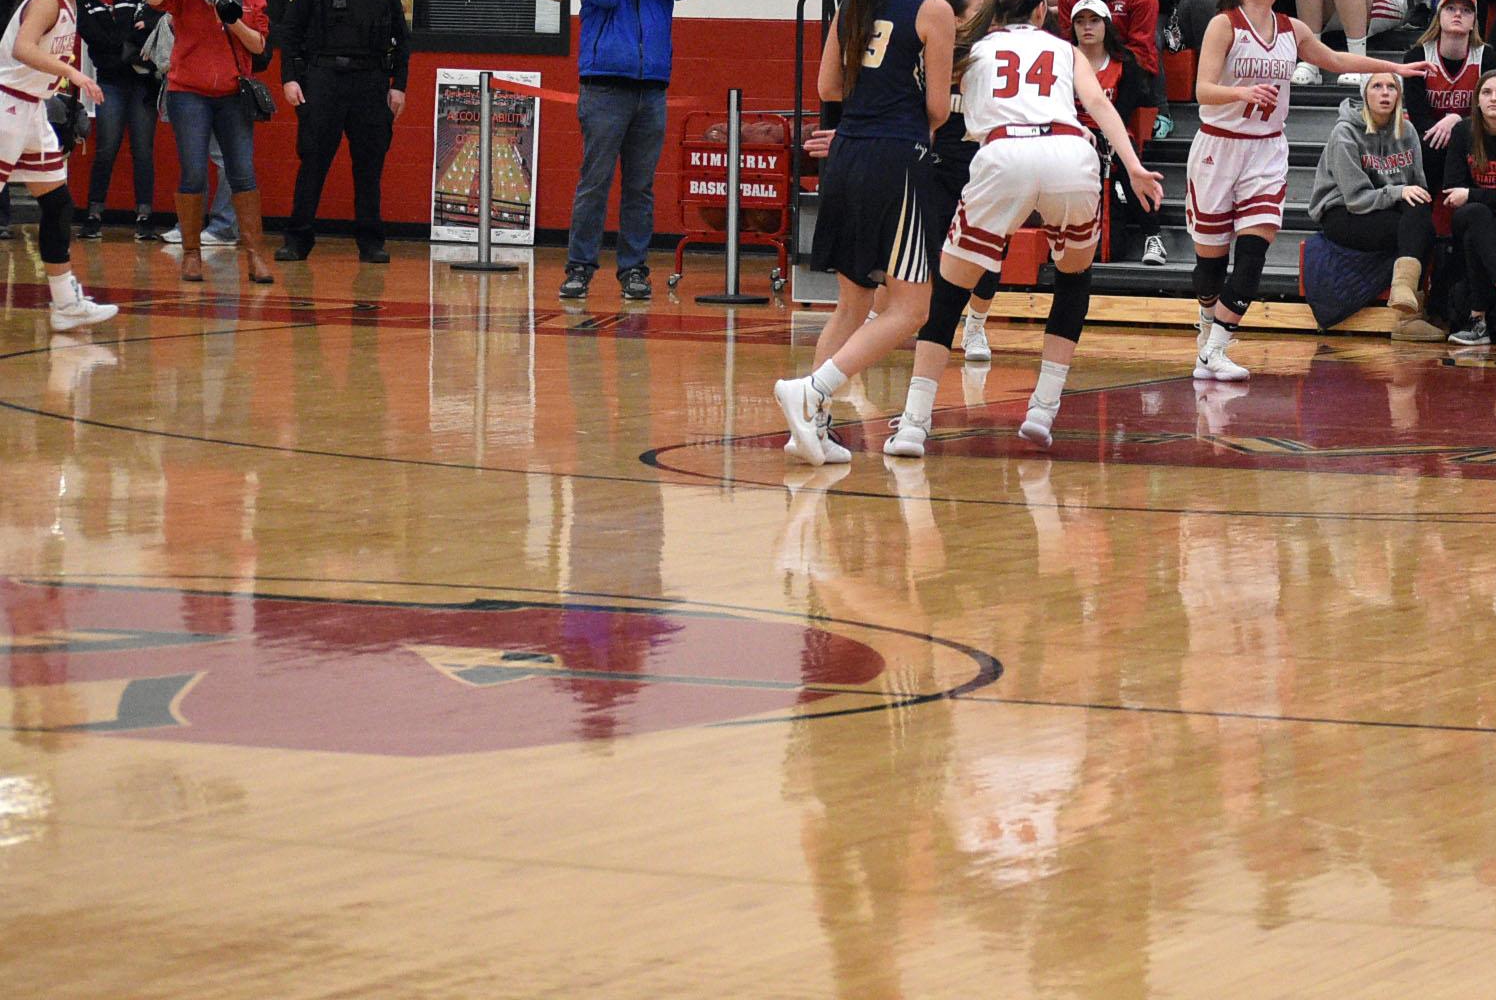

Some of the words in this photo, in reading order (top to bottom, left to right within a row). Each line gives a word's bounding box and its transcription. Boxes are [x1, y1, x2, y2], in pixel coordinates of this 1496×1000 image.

[992, 50, 1058, 99] 34
[1234, 58, 1295, 80] KIMBERL
[447, 110, 526, 123] ACCOUABILITY
[691, 152, 777, 169] KIMRLY
[689, 181, 777, 198] BASKBALL
